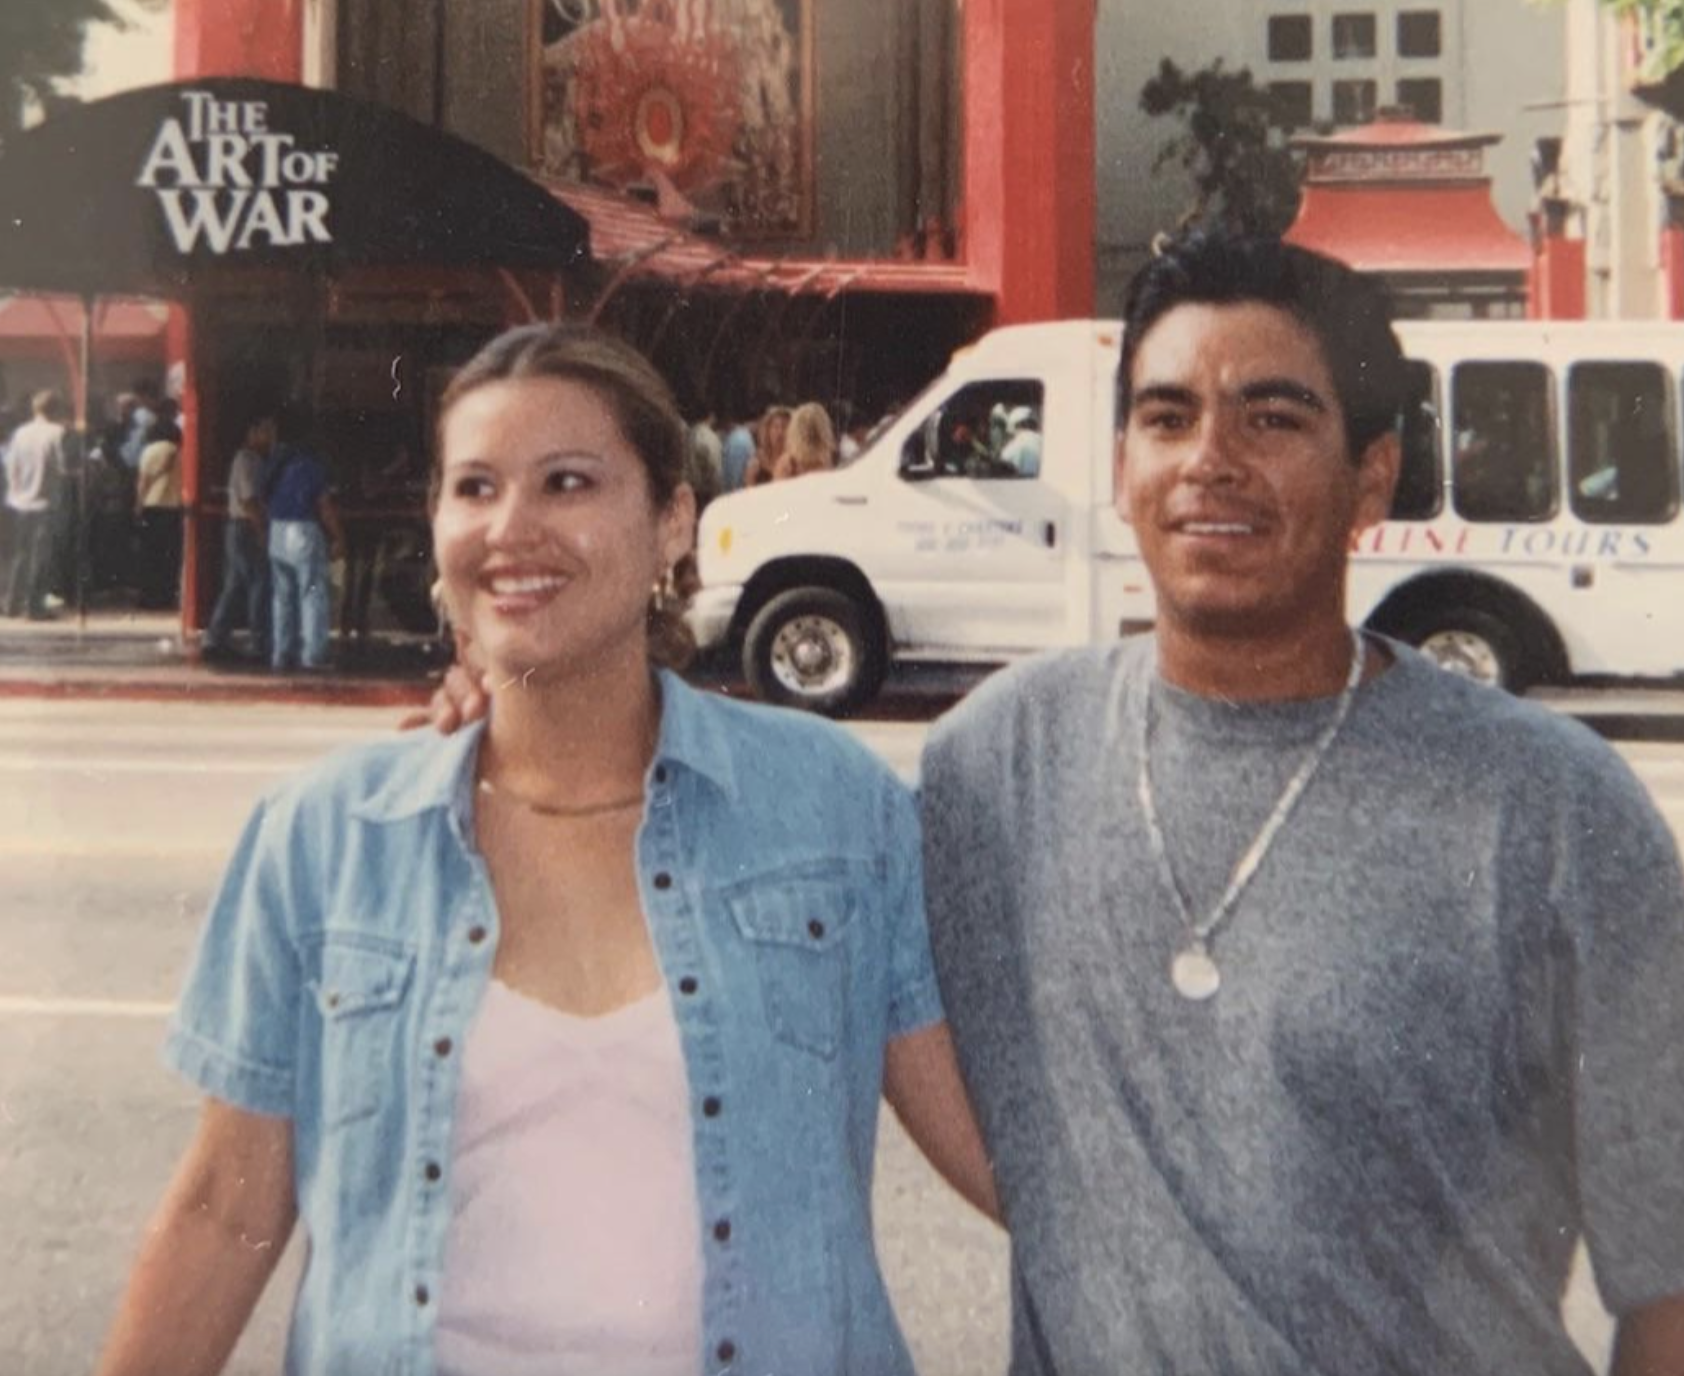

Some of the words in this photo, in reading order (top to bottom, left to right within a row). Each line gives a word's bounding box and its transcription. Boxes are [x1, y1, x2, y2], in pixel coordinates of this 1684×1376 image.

[180, 91, 269, 142] THE
[136, 117, 295, 187] ART
[281, 151, 340, 183] OF
[156, 189, 333, 253] WAR
[1502, 526, 1652, 556] TOURS
